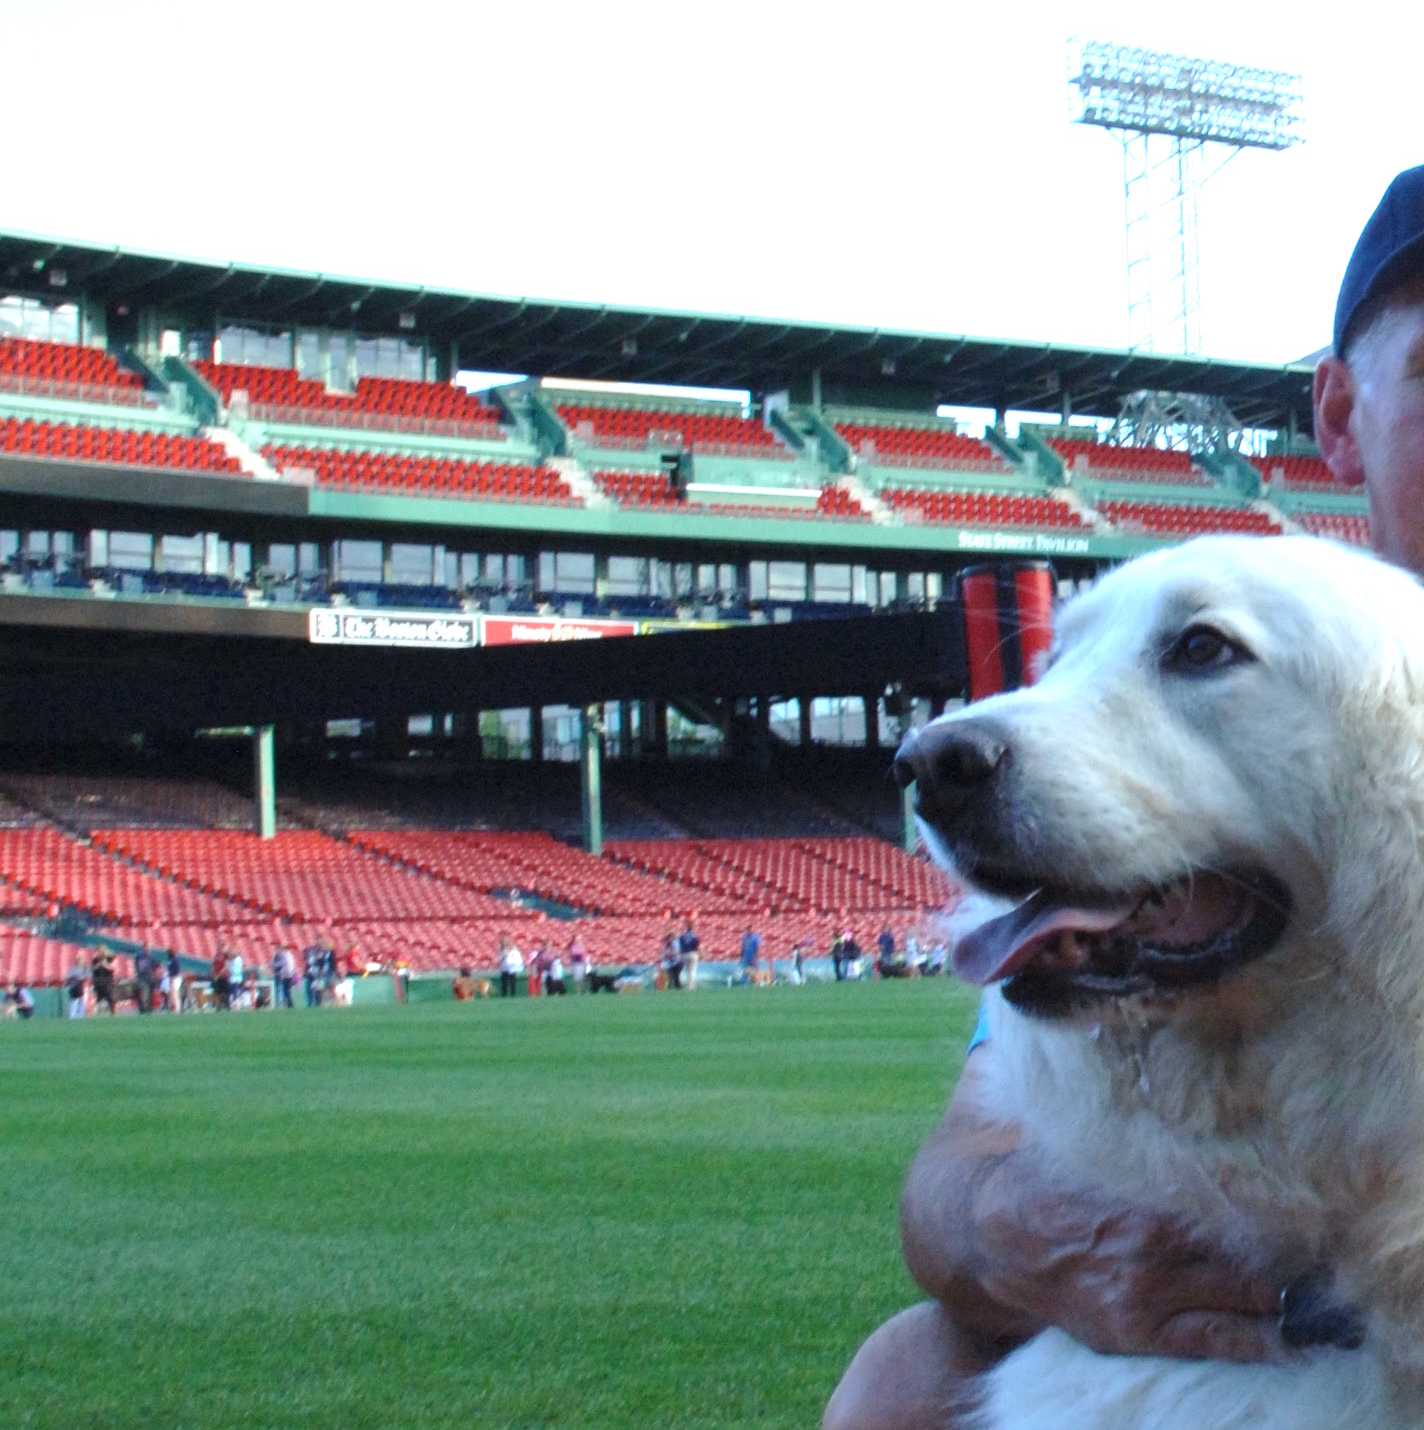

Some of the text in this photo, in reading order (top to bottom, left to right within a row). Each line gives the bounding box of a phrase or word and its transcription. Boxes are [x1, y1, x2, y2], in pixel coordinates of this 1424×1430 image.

[958, 531, 1089, 552] STATE STREET PAVILION
[344, 617, 469, 642] The Boston Globe
